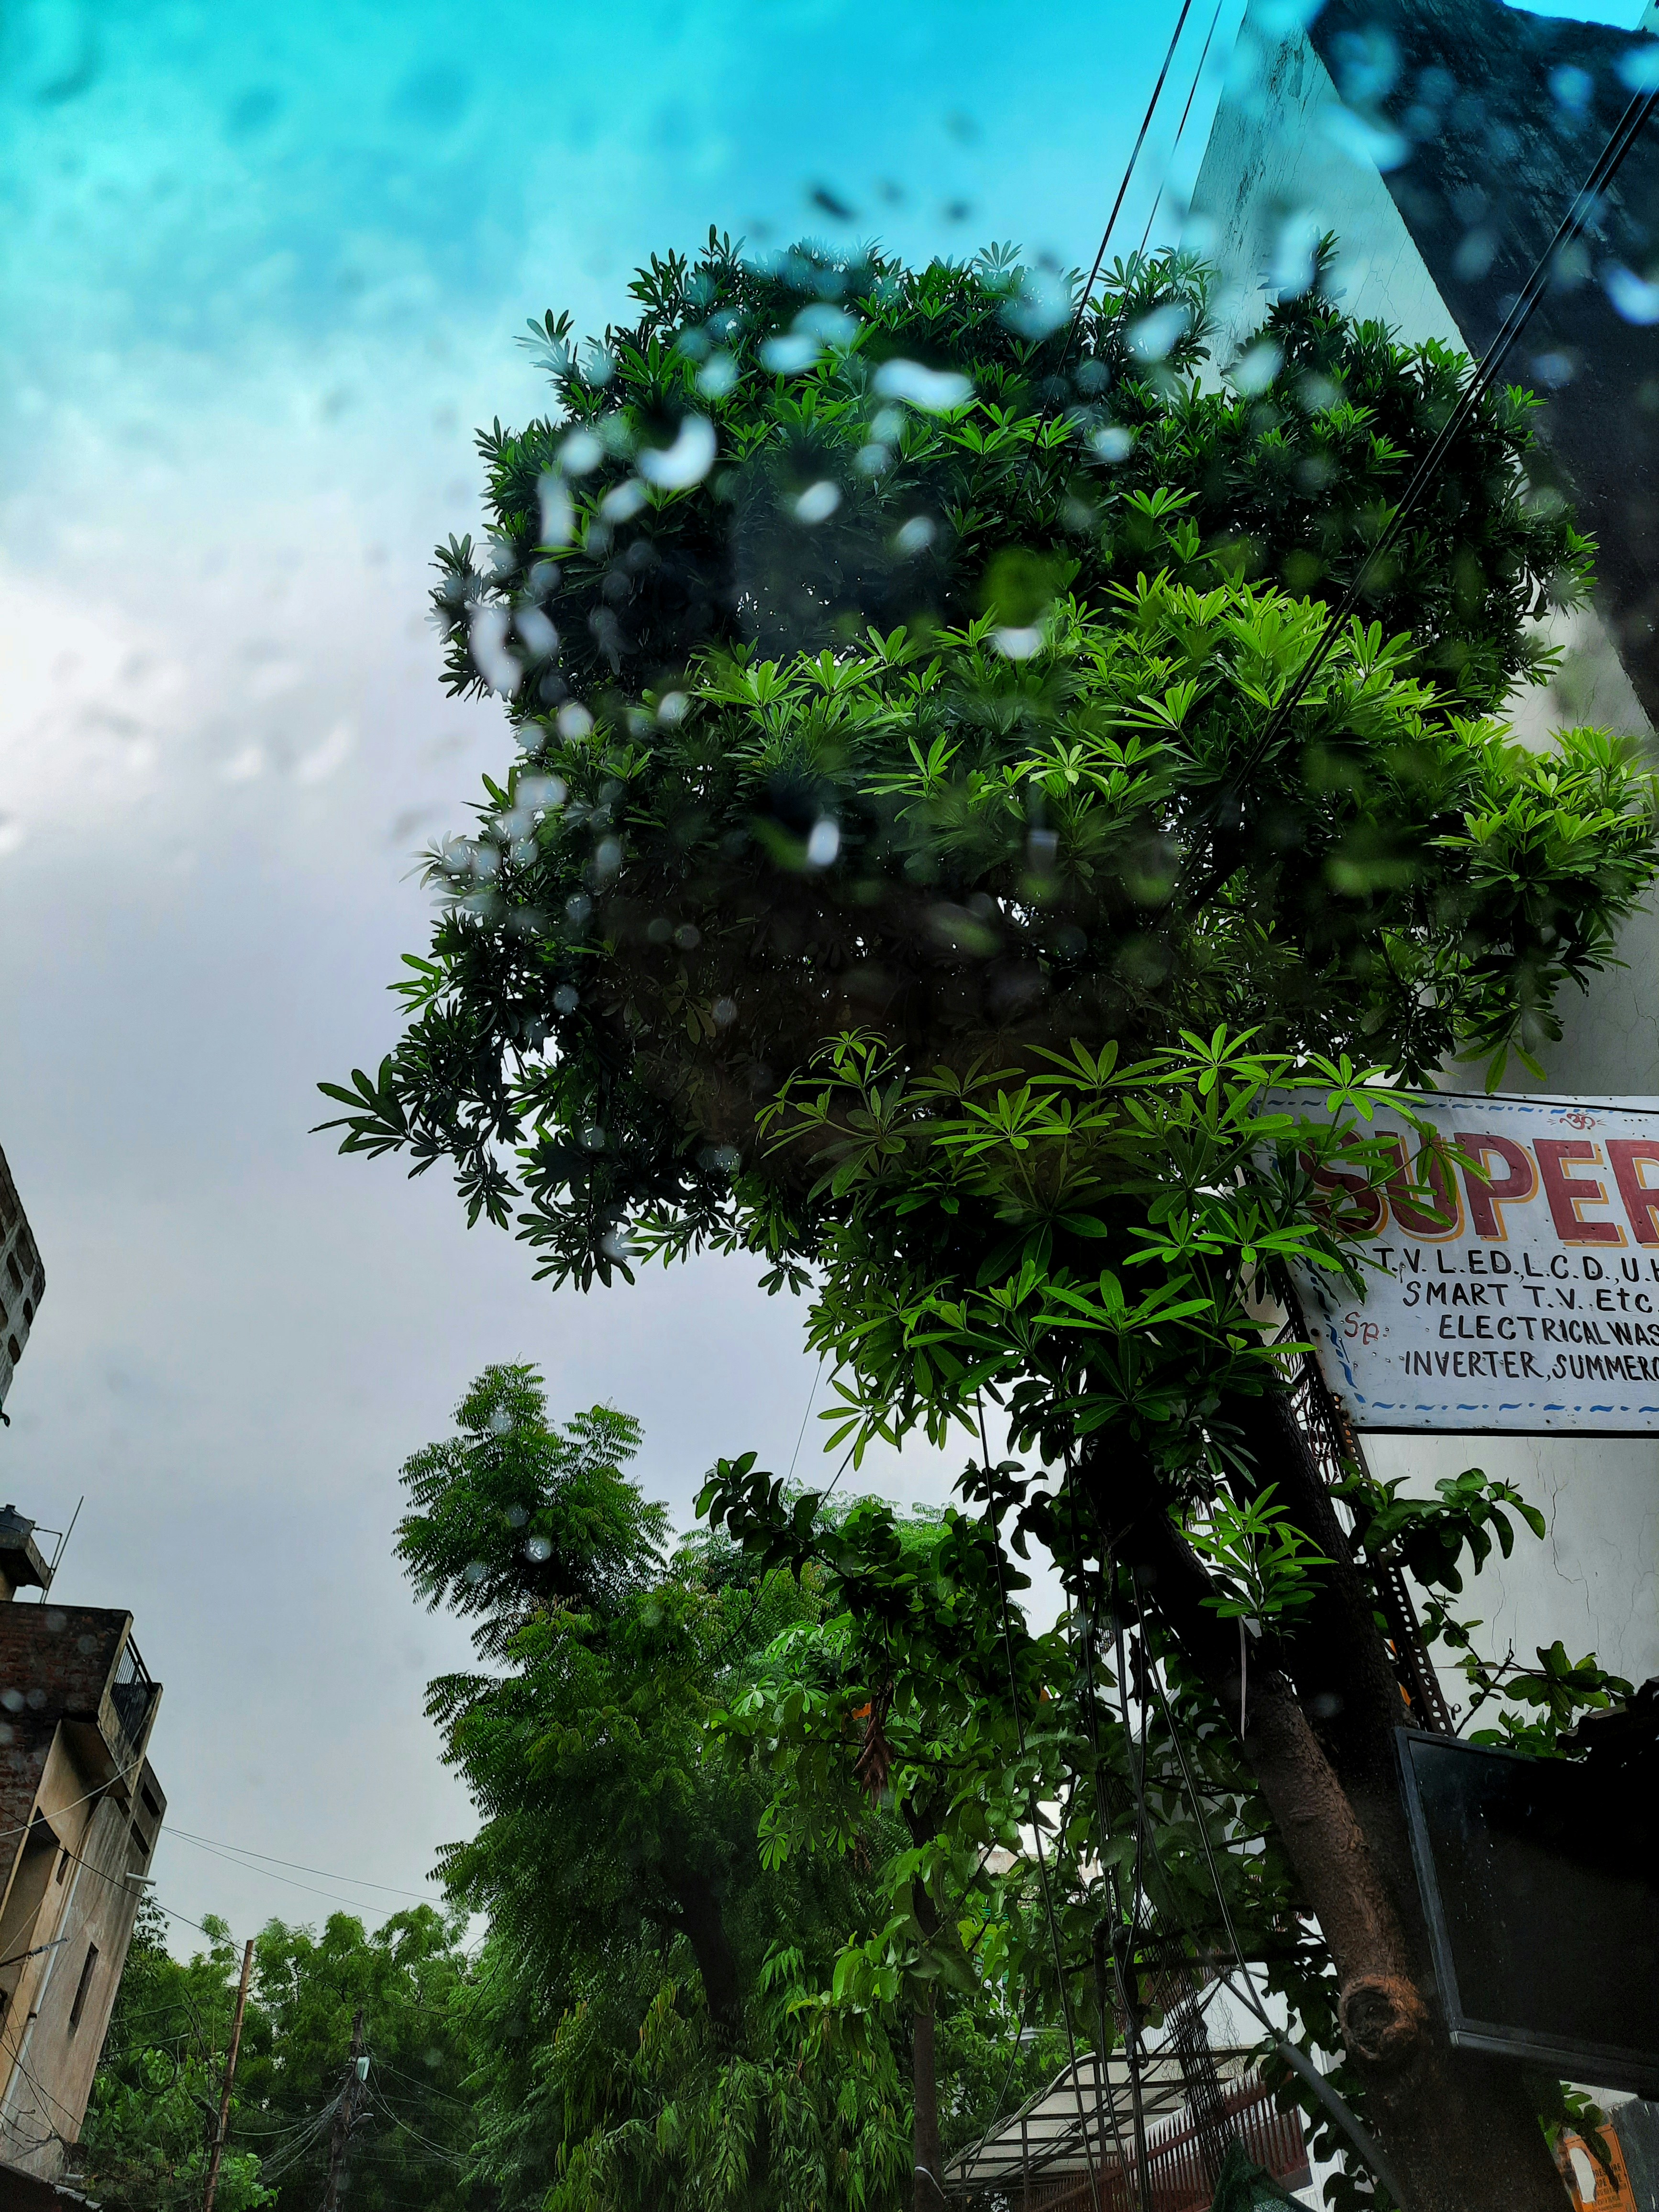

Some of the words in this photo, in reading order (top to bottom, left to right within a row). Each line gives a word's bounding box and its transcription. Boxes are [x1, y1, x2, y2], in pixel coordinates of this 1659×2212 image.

[1298, 1129, 1659, 1249] SUPER
[1403, 1281, 1509, 1308] SMART
[1522, 1285, 1584, 1310] T.V.
[1439, 1315, 1611, 1345] ELECTRICAL
